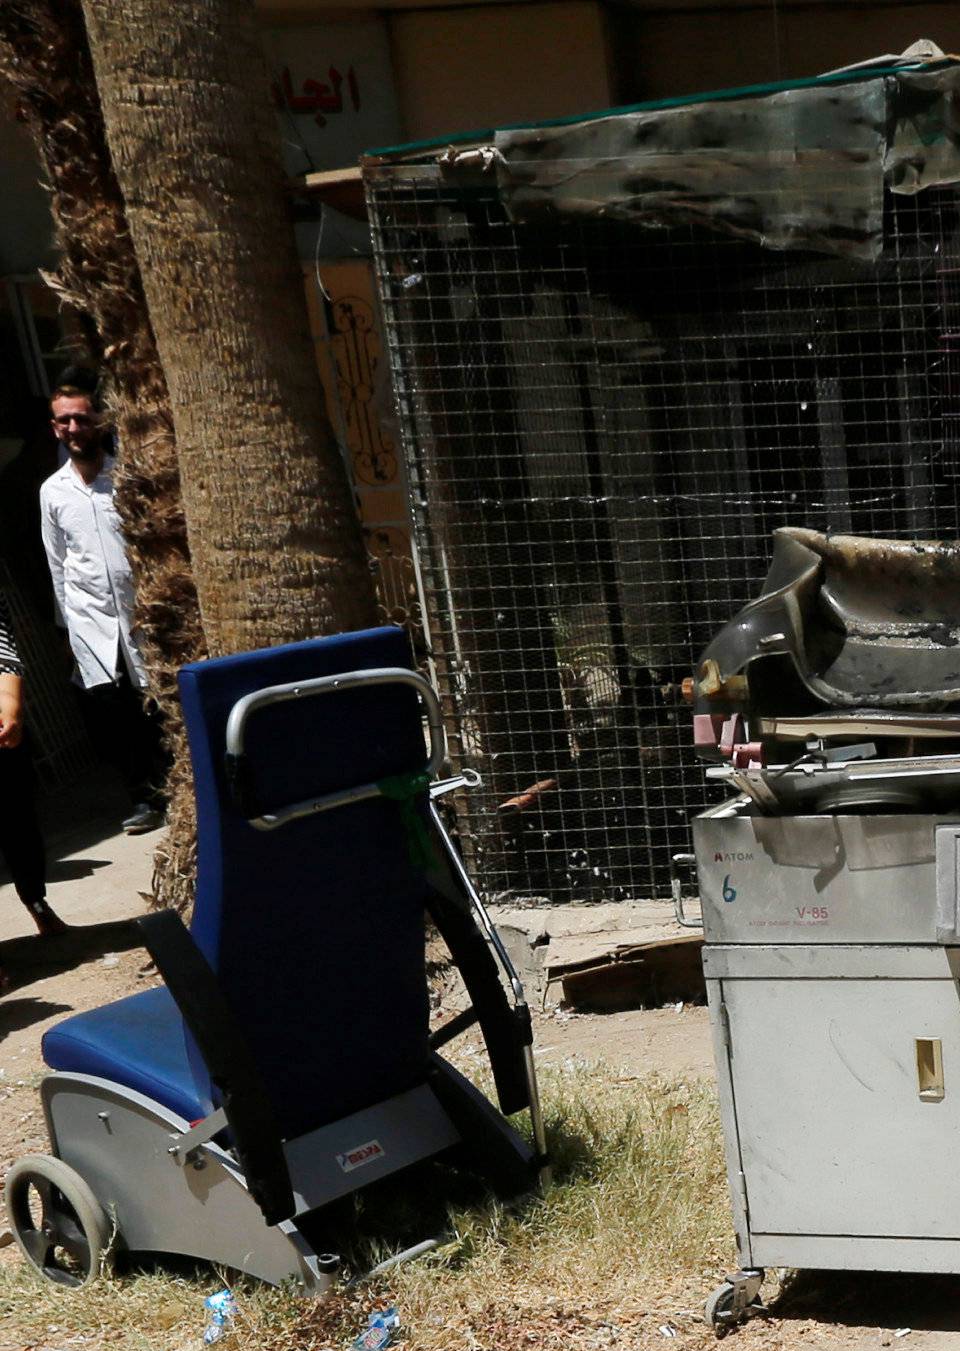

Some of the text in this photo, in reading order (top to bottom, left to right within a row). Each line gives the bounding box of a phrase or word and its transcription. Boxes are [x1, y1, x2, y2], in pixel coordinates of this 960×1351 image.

[723, 852, 754, 861] ATOM
[722, 873, 737, 903] 6
[795, 906, 829, 919] V-85
